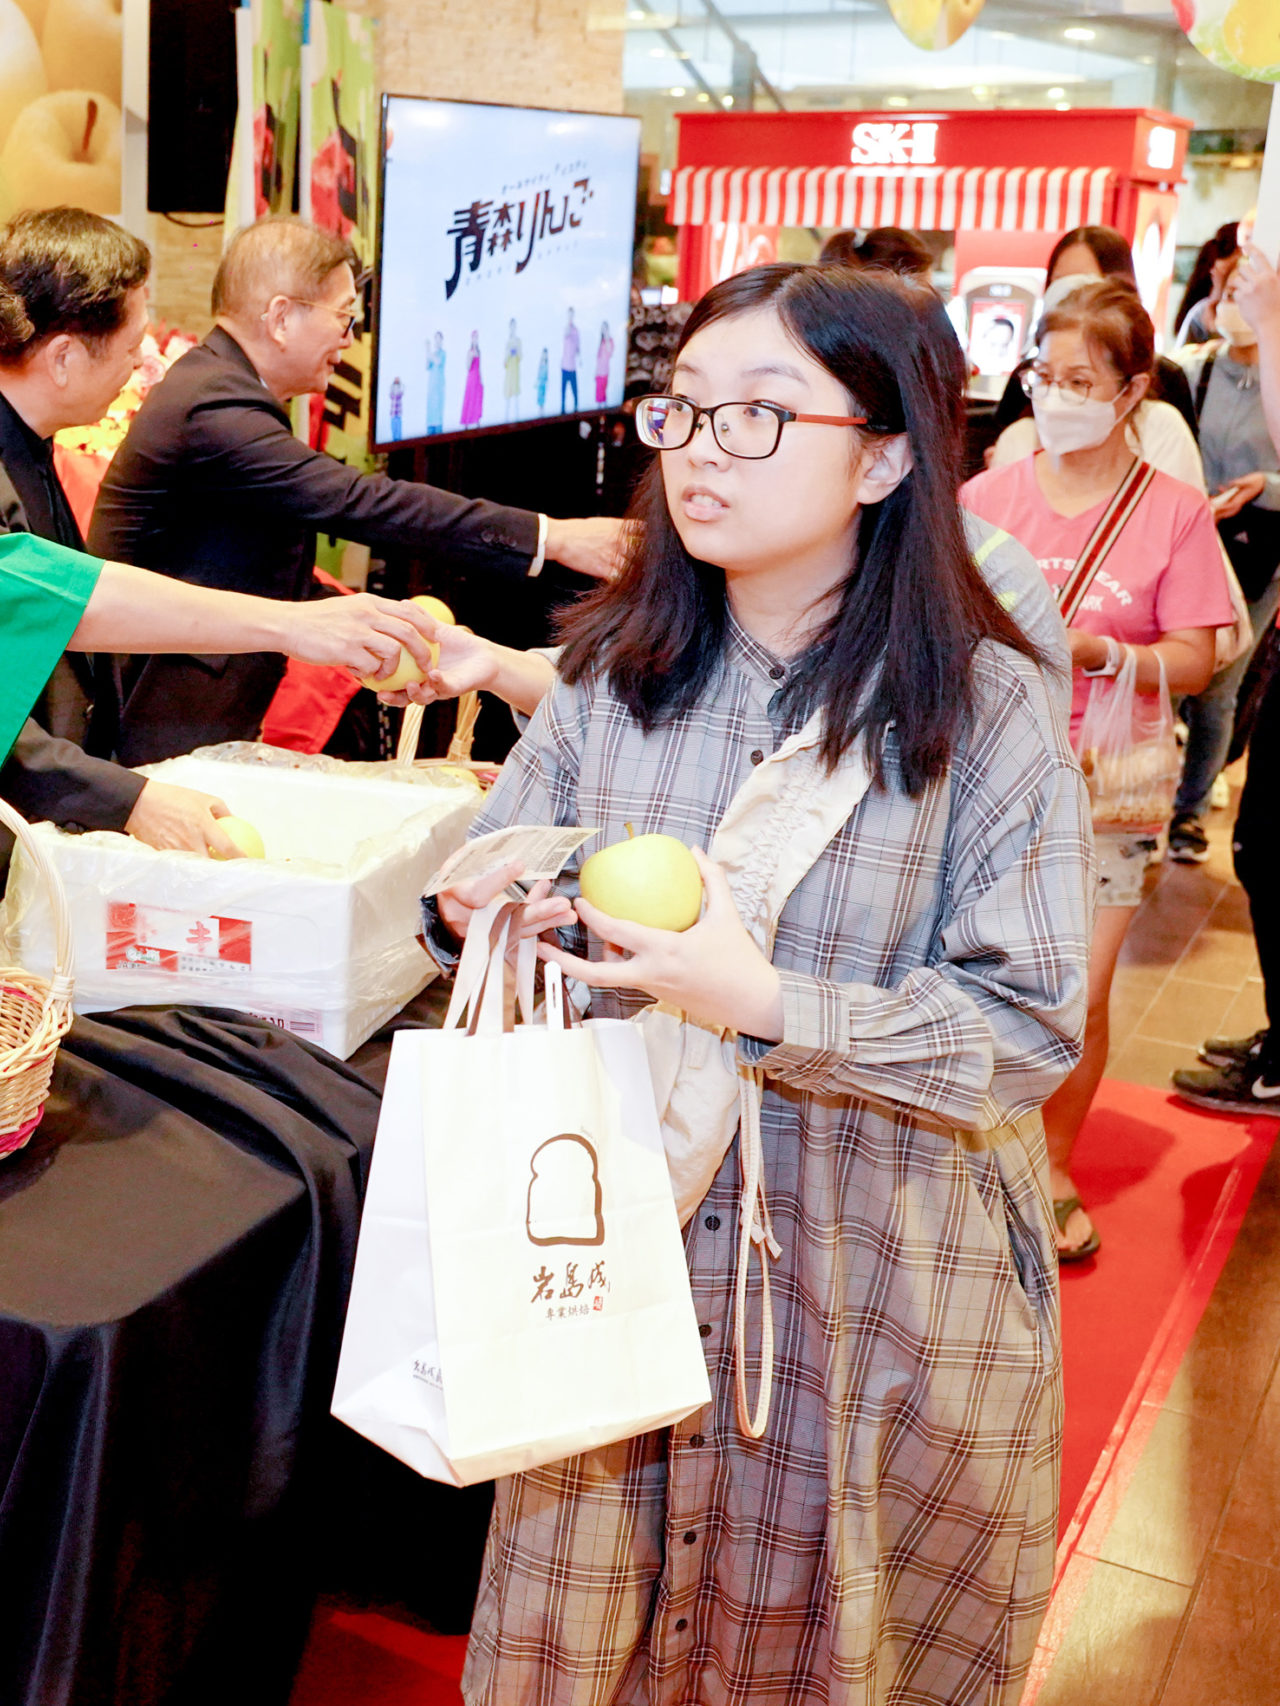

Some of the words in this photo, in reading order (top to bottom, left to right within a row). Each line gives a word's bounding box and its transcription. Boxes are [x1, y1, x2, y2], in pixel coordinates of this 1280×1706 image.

[445, 177, 594, 301] 青森りんご
